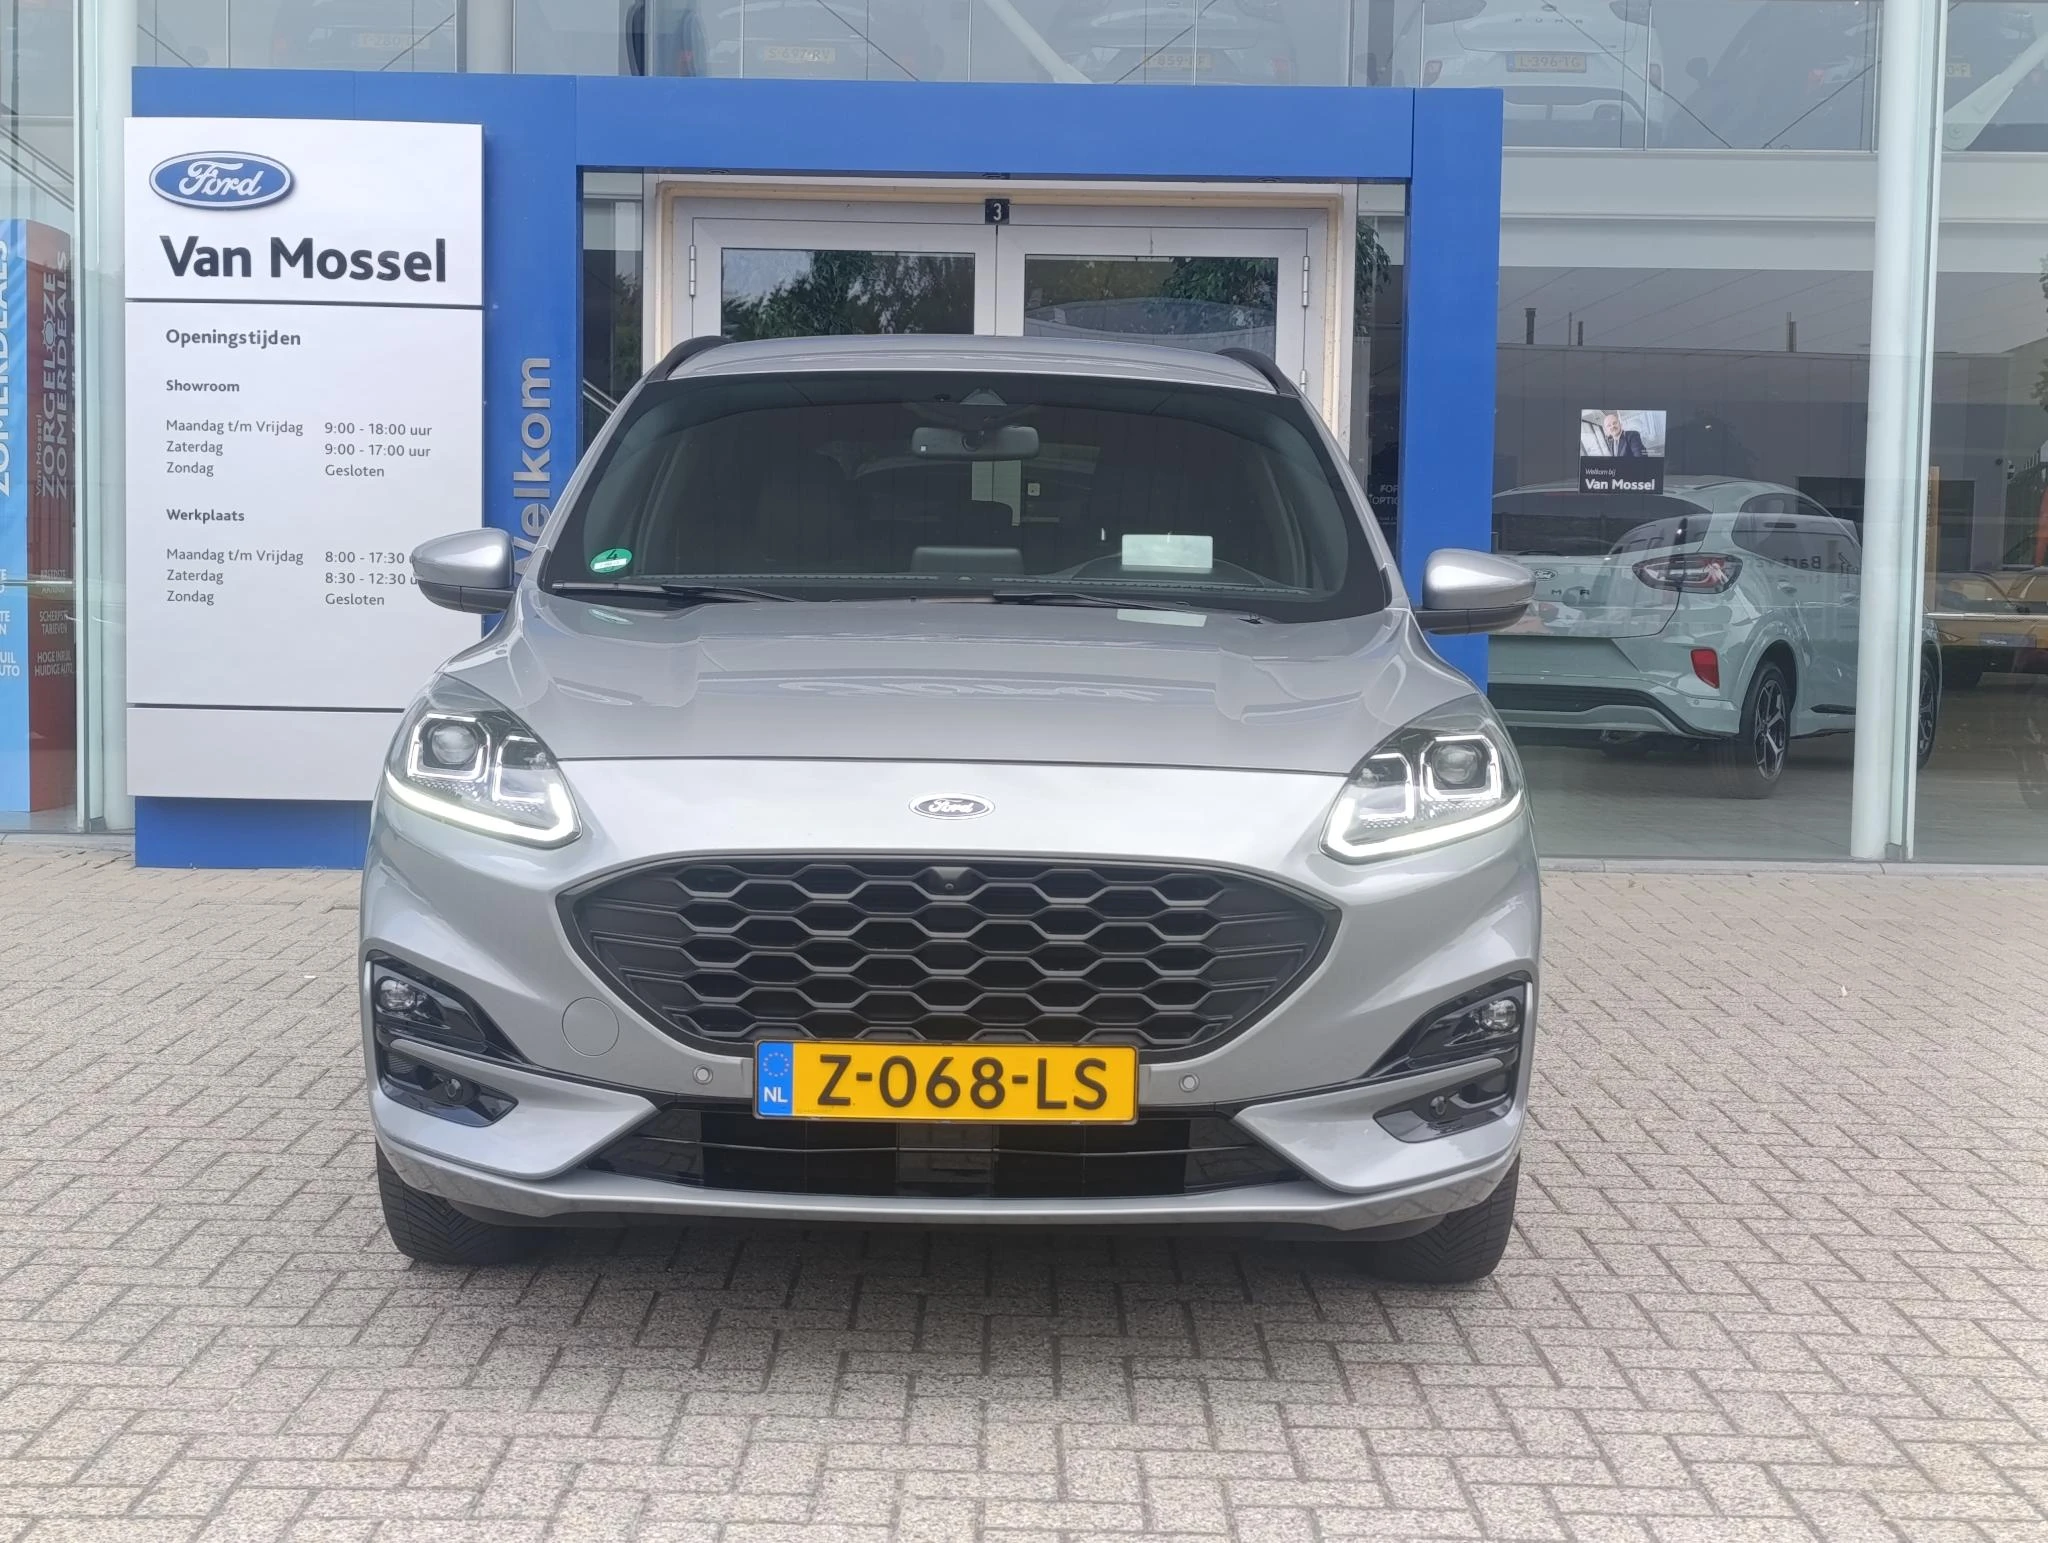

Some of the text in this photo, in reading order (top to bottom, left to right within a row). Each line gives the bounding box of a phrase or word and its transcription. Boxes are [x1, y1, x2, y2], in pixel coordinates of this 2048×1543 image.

[179, 160, 262, 198] Ford
[994, 203, 1001, 220] 3
[160, 236, 446, 282] Van Mossel
[166, 328, 301, 349] Openingstijden
[56, 250, 68, 499] ZOMERDEALS
[166, 379, 240, 393] Showroom
[166, 419, 225, 435] Maandag
[228, 419, 252, 433] t/m
[256, 420, 304, 437] Vrijdag
[325, 422, 355, 435] 9:00
[369, 423, 406, 435] 18:00
[410, 426, 432, 437] uur
[166, 440, 223, 456] Zaterdag
[325, 443, 355, 456] 9:00
[368, 444, 405, 457] 17:00
[409, 447, 431, 457] uur
[166, 461, 385, 477] Zondag Gesloten
[1585, 478, 1656, 491] Van Mossel
[166, 509, 245, 524] Werkplaats
[167, 548, 225, 564] Maandag
[228, 548, 252, 562] t/m
[256, 549, 304, 565] Vrijdag
[325, 551, 355, 563] 8:00
[369, 552, 405, 564] 17:30
[167, 569, 224, 585] Zaterdag
[325, 572, 355, 584] 8:30
[369, 573, 406, 585] 12:30
[167, 590, 385, 606] Zondag Gesloten
[37, 651, 55, 663] HOGE
[0, 665, 20, 677] UTO
[817, 1053, 1108, 1111] Z-068-LS
[763, 1086, 788, 1104] NL
